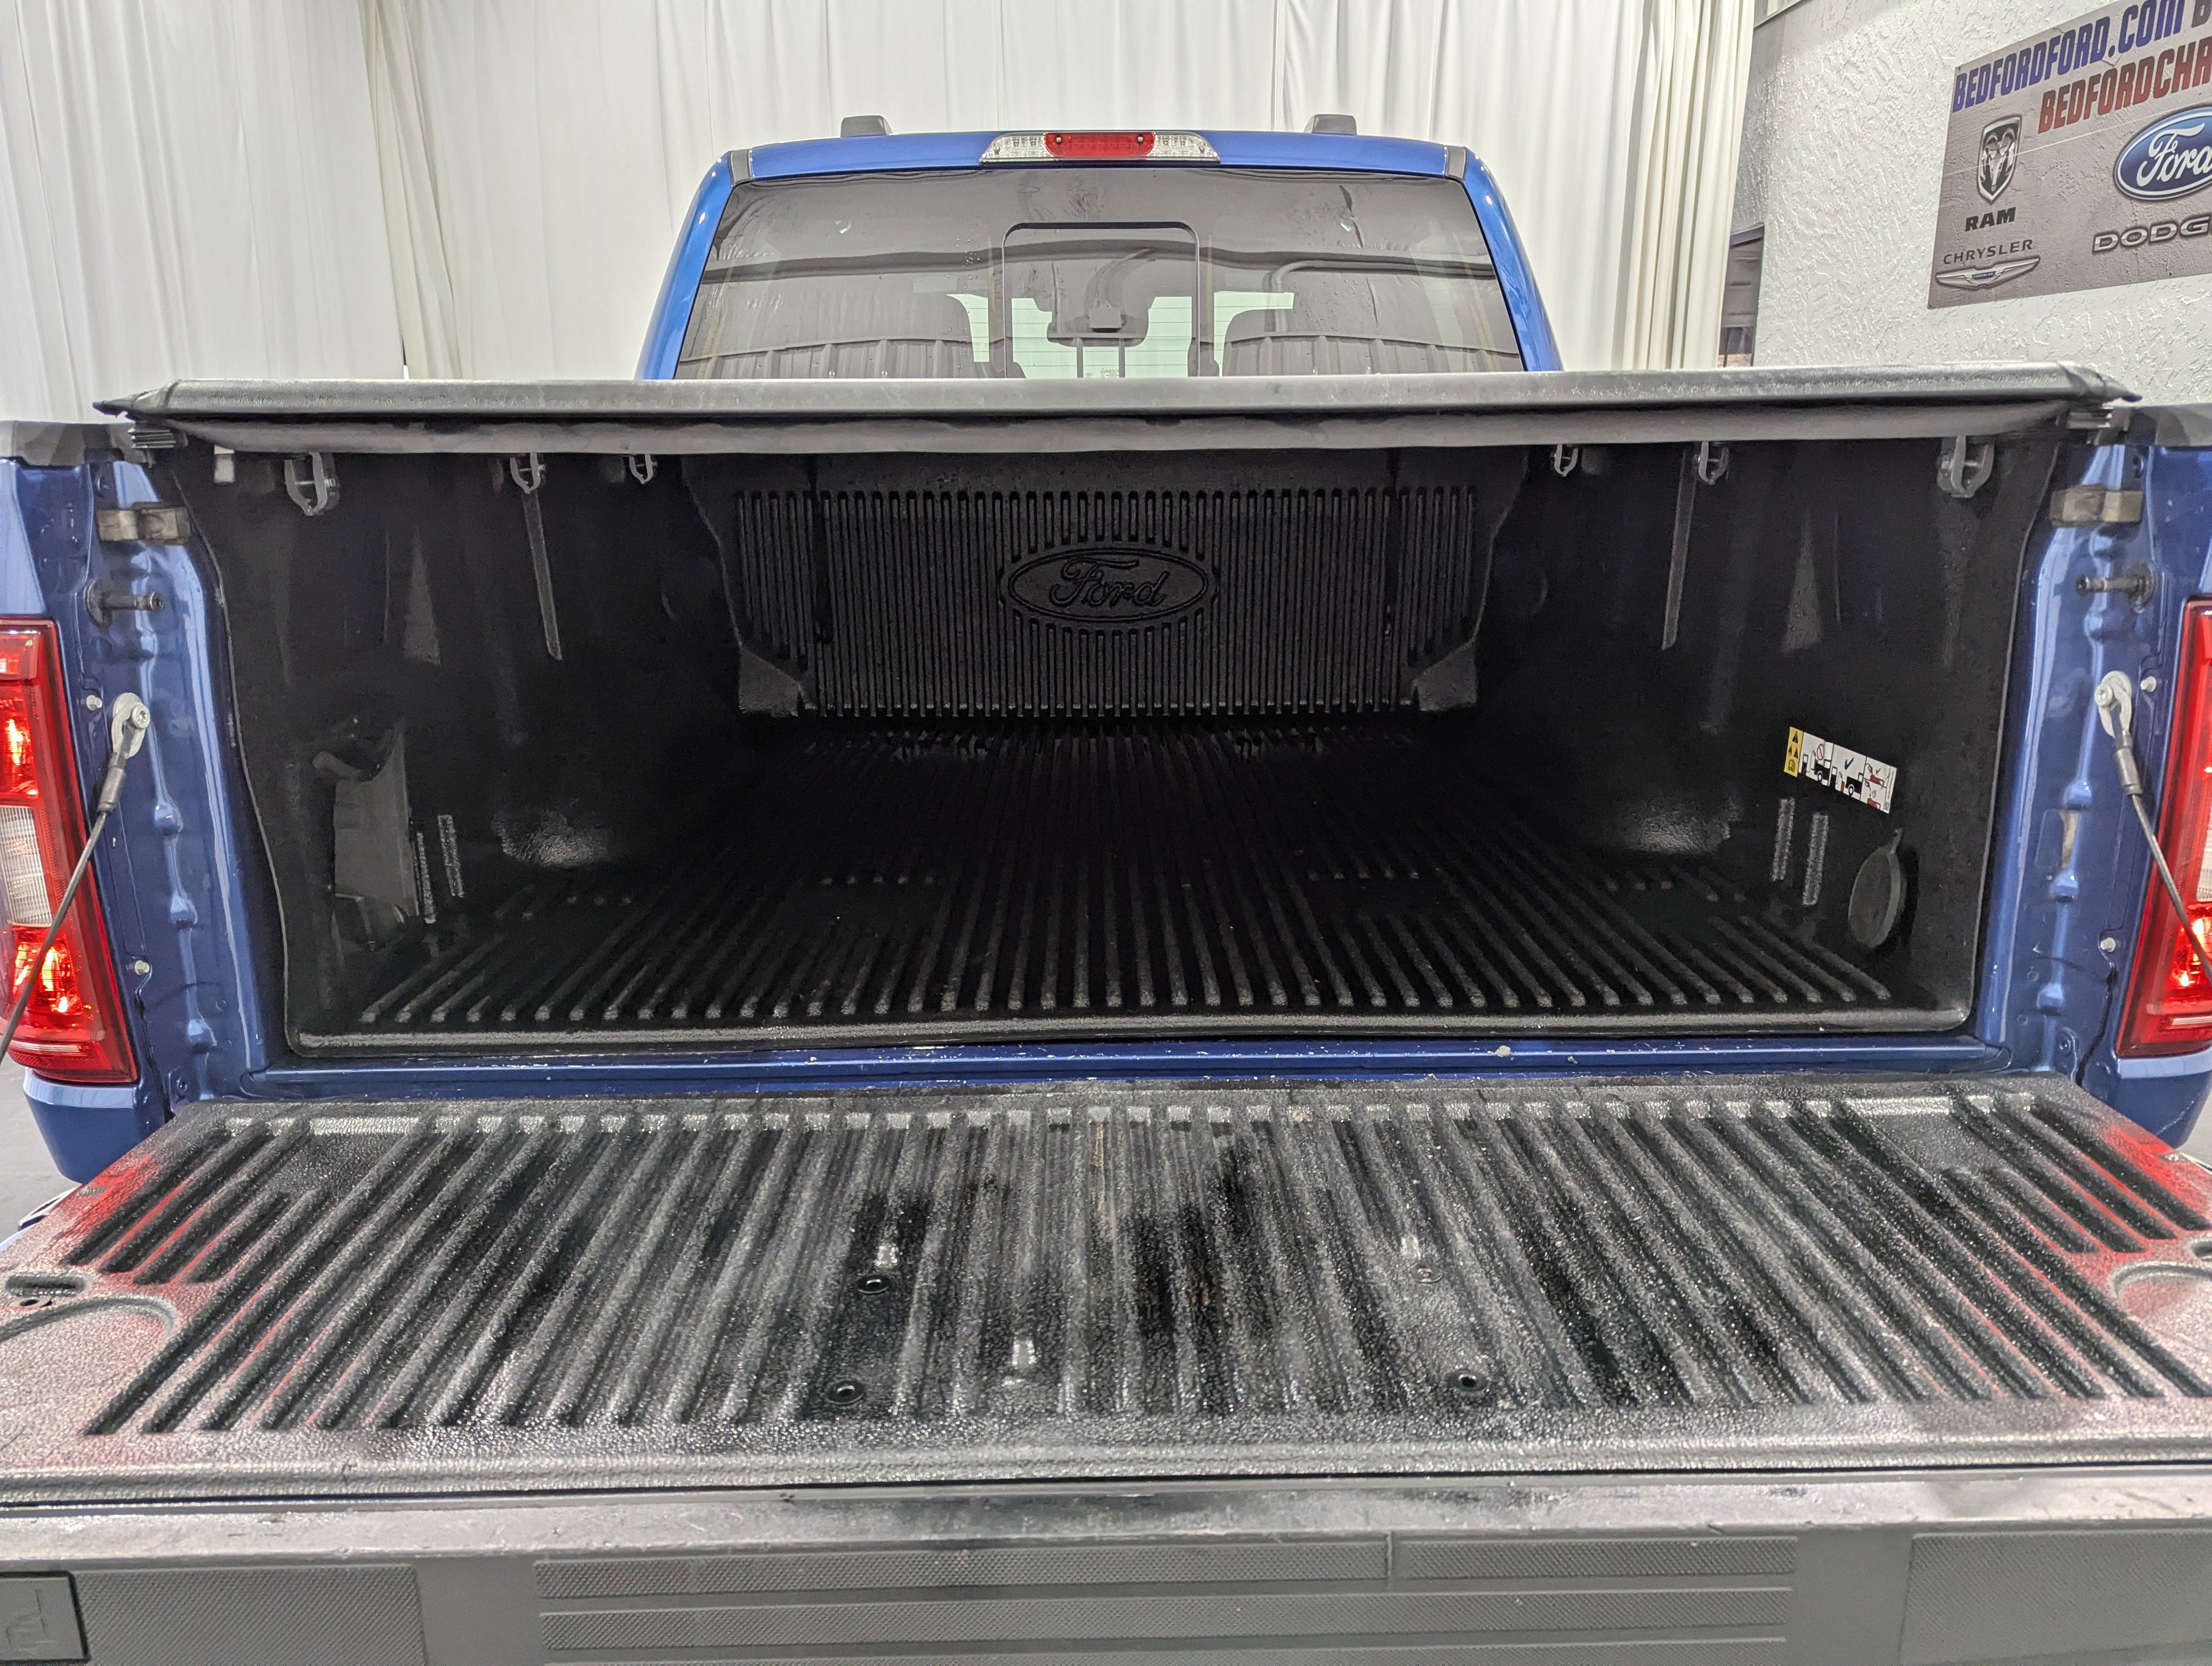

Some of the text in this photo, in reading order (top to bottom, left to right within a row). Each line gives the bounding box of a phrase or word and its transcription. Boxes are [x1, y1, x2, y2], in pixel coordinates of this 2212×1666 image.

[1952, 0, 2185, 113] BEDFORDFORD.COM
[1965, 207, 2016, 232] RAM
[1943, 239, 2033, 265] CHRYSLER
[1049, 557, 1170, 607] Ford
